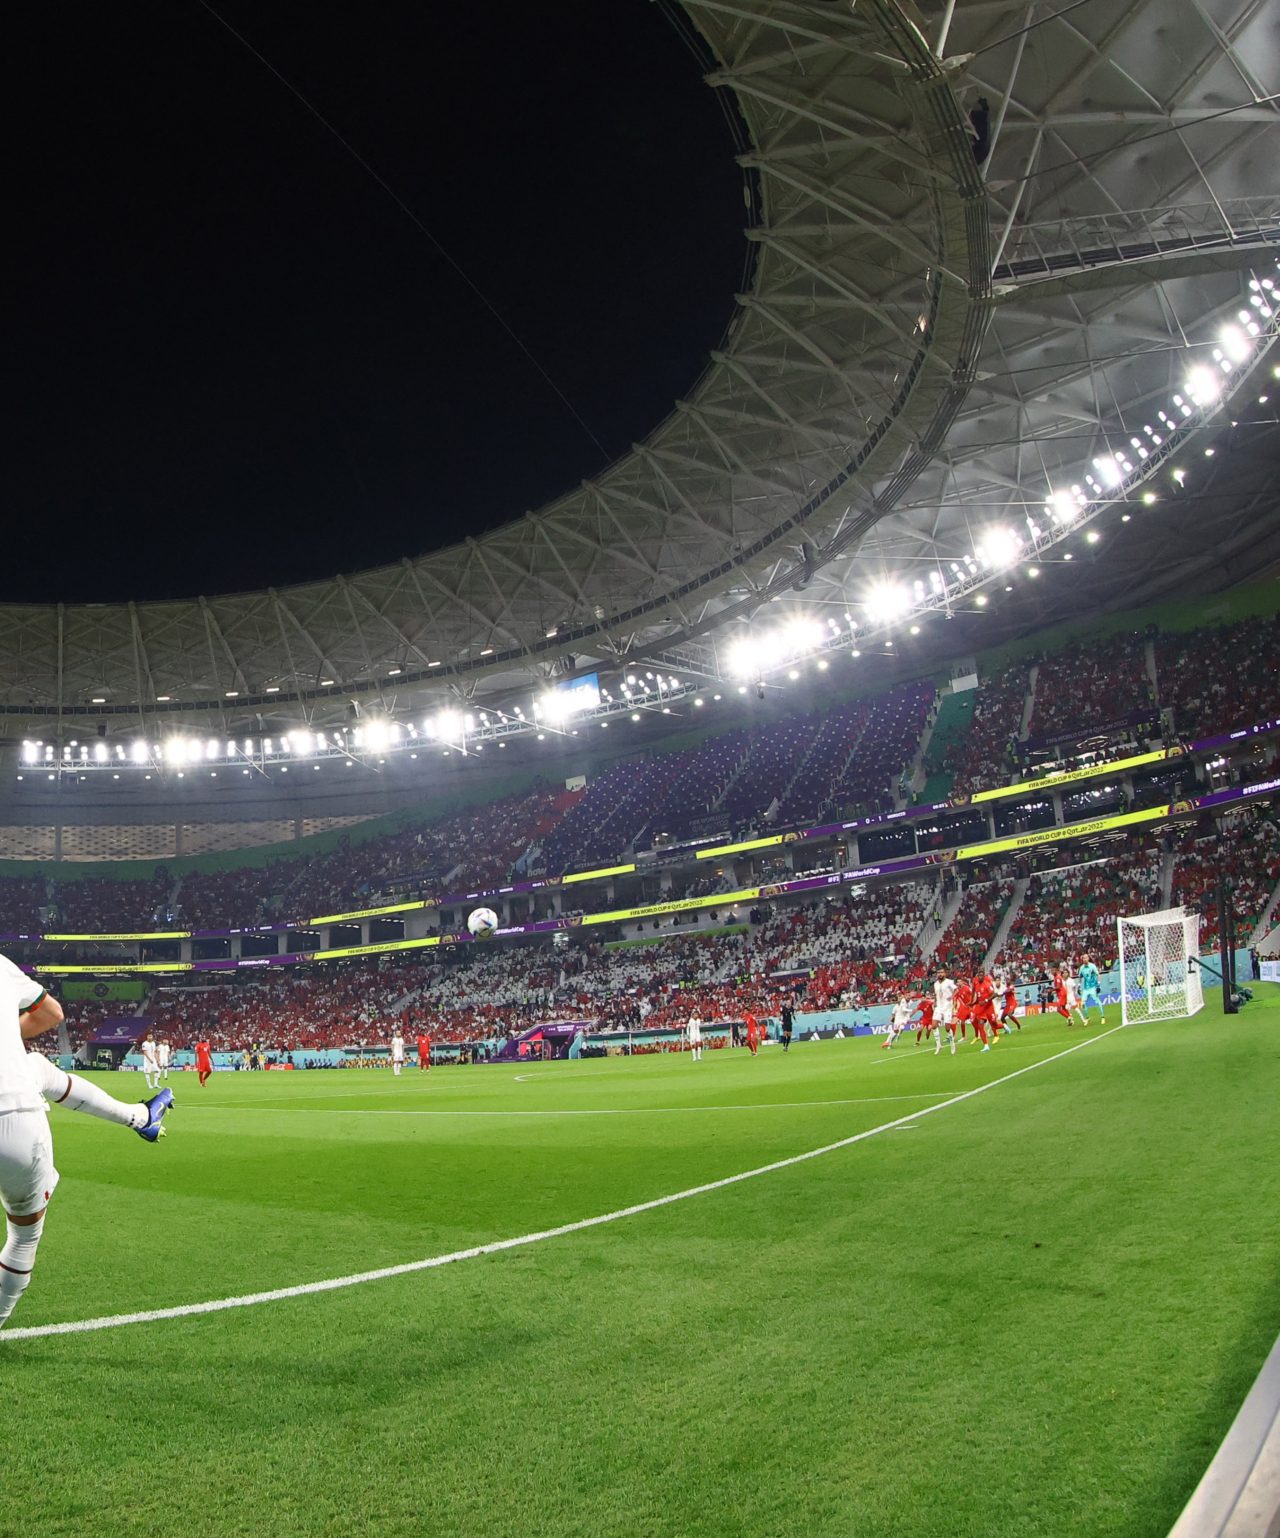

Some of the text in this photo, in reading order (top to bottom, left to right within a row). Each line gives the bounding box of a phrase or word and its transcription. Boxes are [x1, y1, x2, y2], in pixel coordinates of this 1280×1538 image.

[1040, 778, 1057, 786] WORLD
[1017, 837, 1029, 846] FIFA
[1030, 833, 1050, 843] WORLD
[1051, 831, 1061, 839] CUP
[640, 907, 657, 915] WORLD
[870, 1024, 892, 1035] VISA
